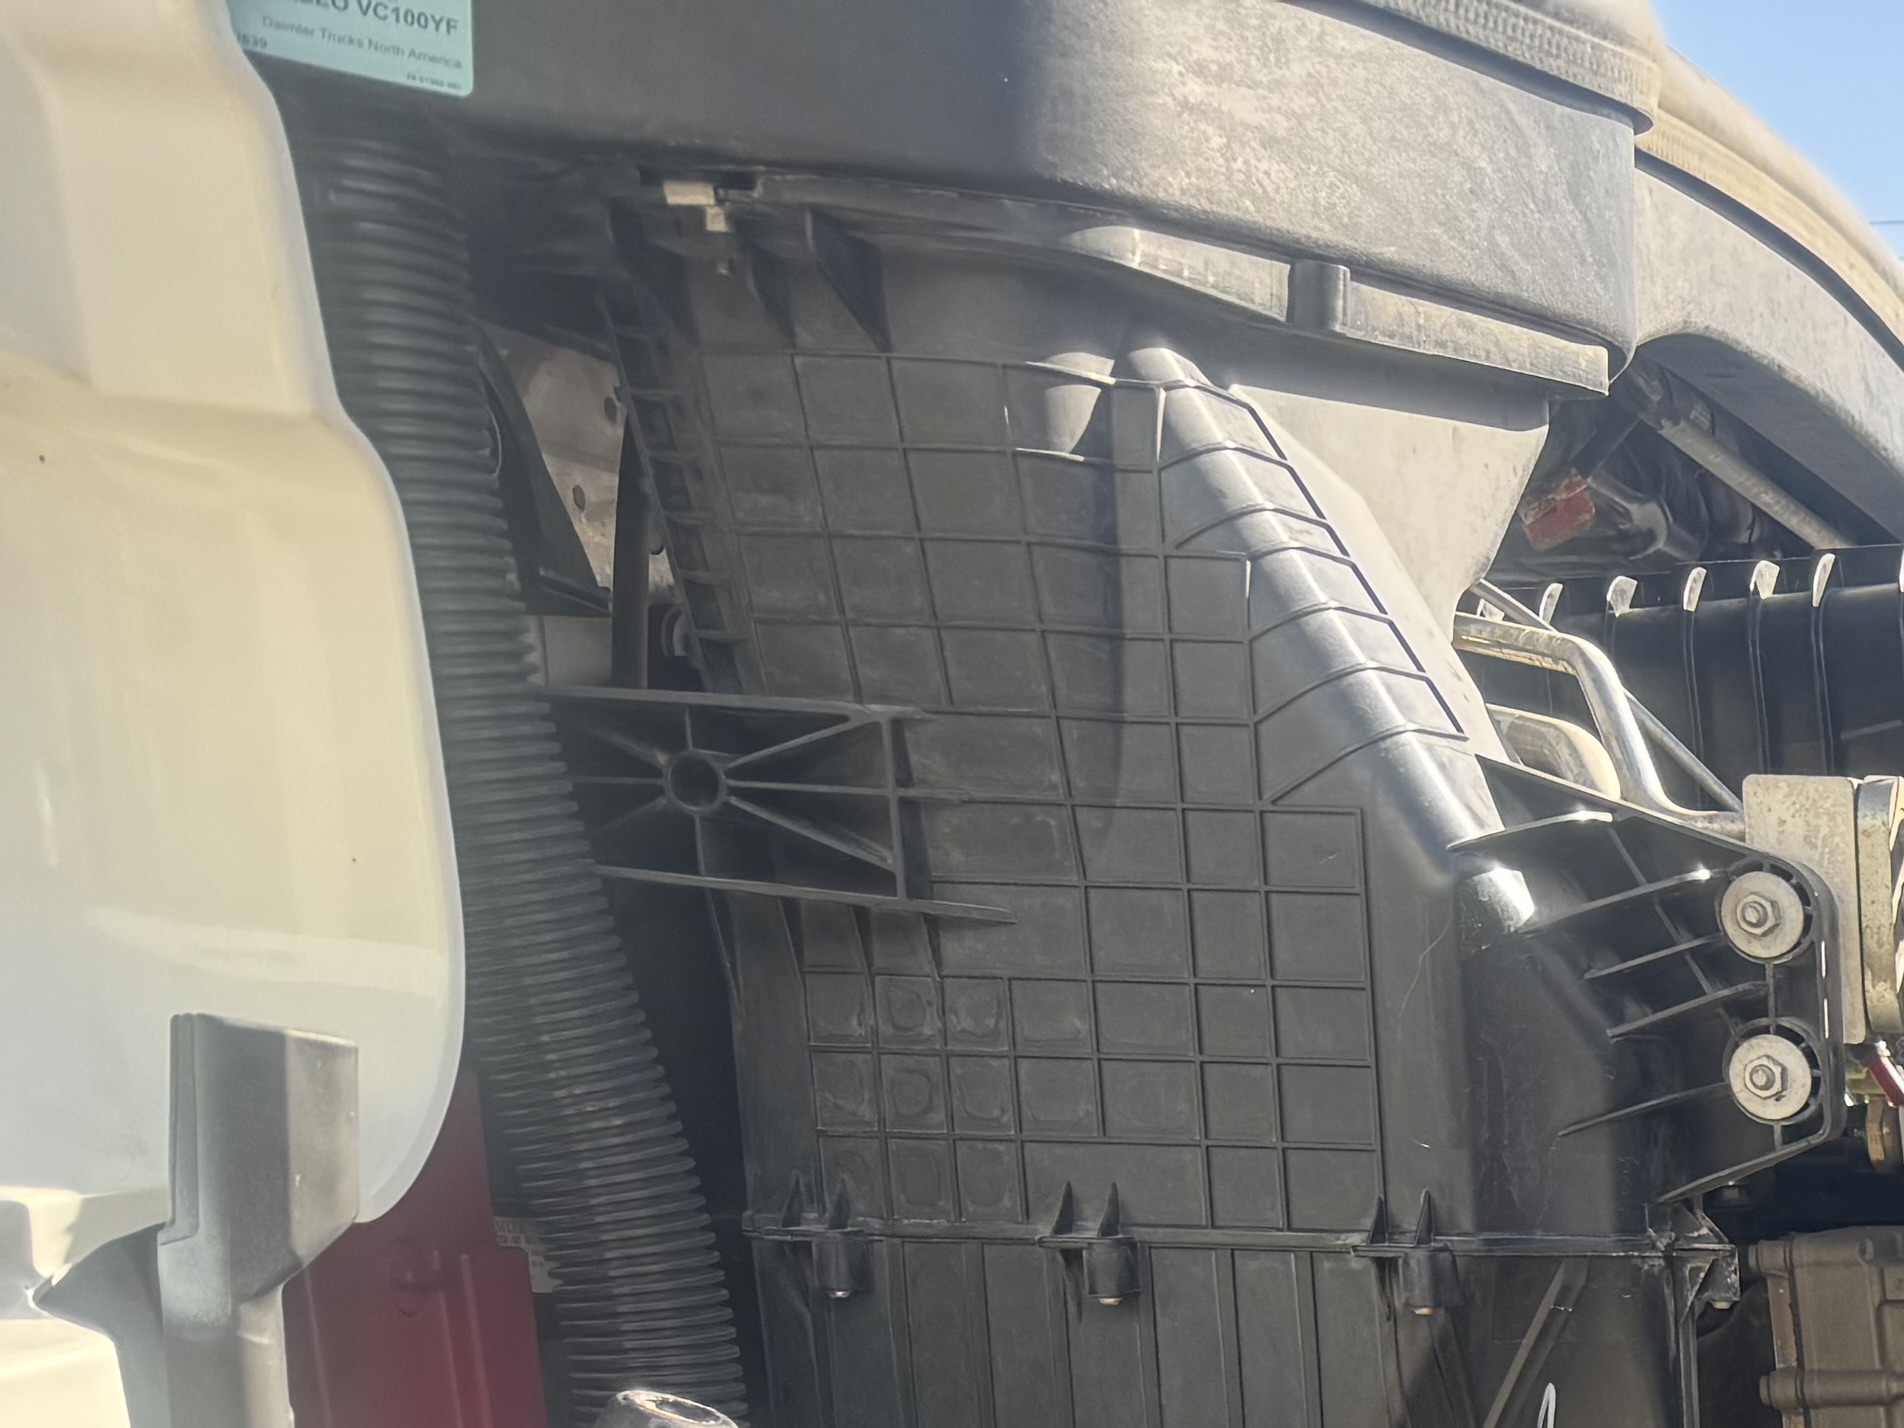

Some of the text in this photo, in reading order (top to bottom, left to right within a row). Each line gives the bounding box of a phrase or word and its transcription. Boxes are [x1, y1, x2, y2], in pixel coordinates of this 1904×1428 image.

[358, 0, 459, 35] VC100YF
[261, 15, 463, 70] Daimler Trucks North America
